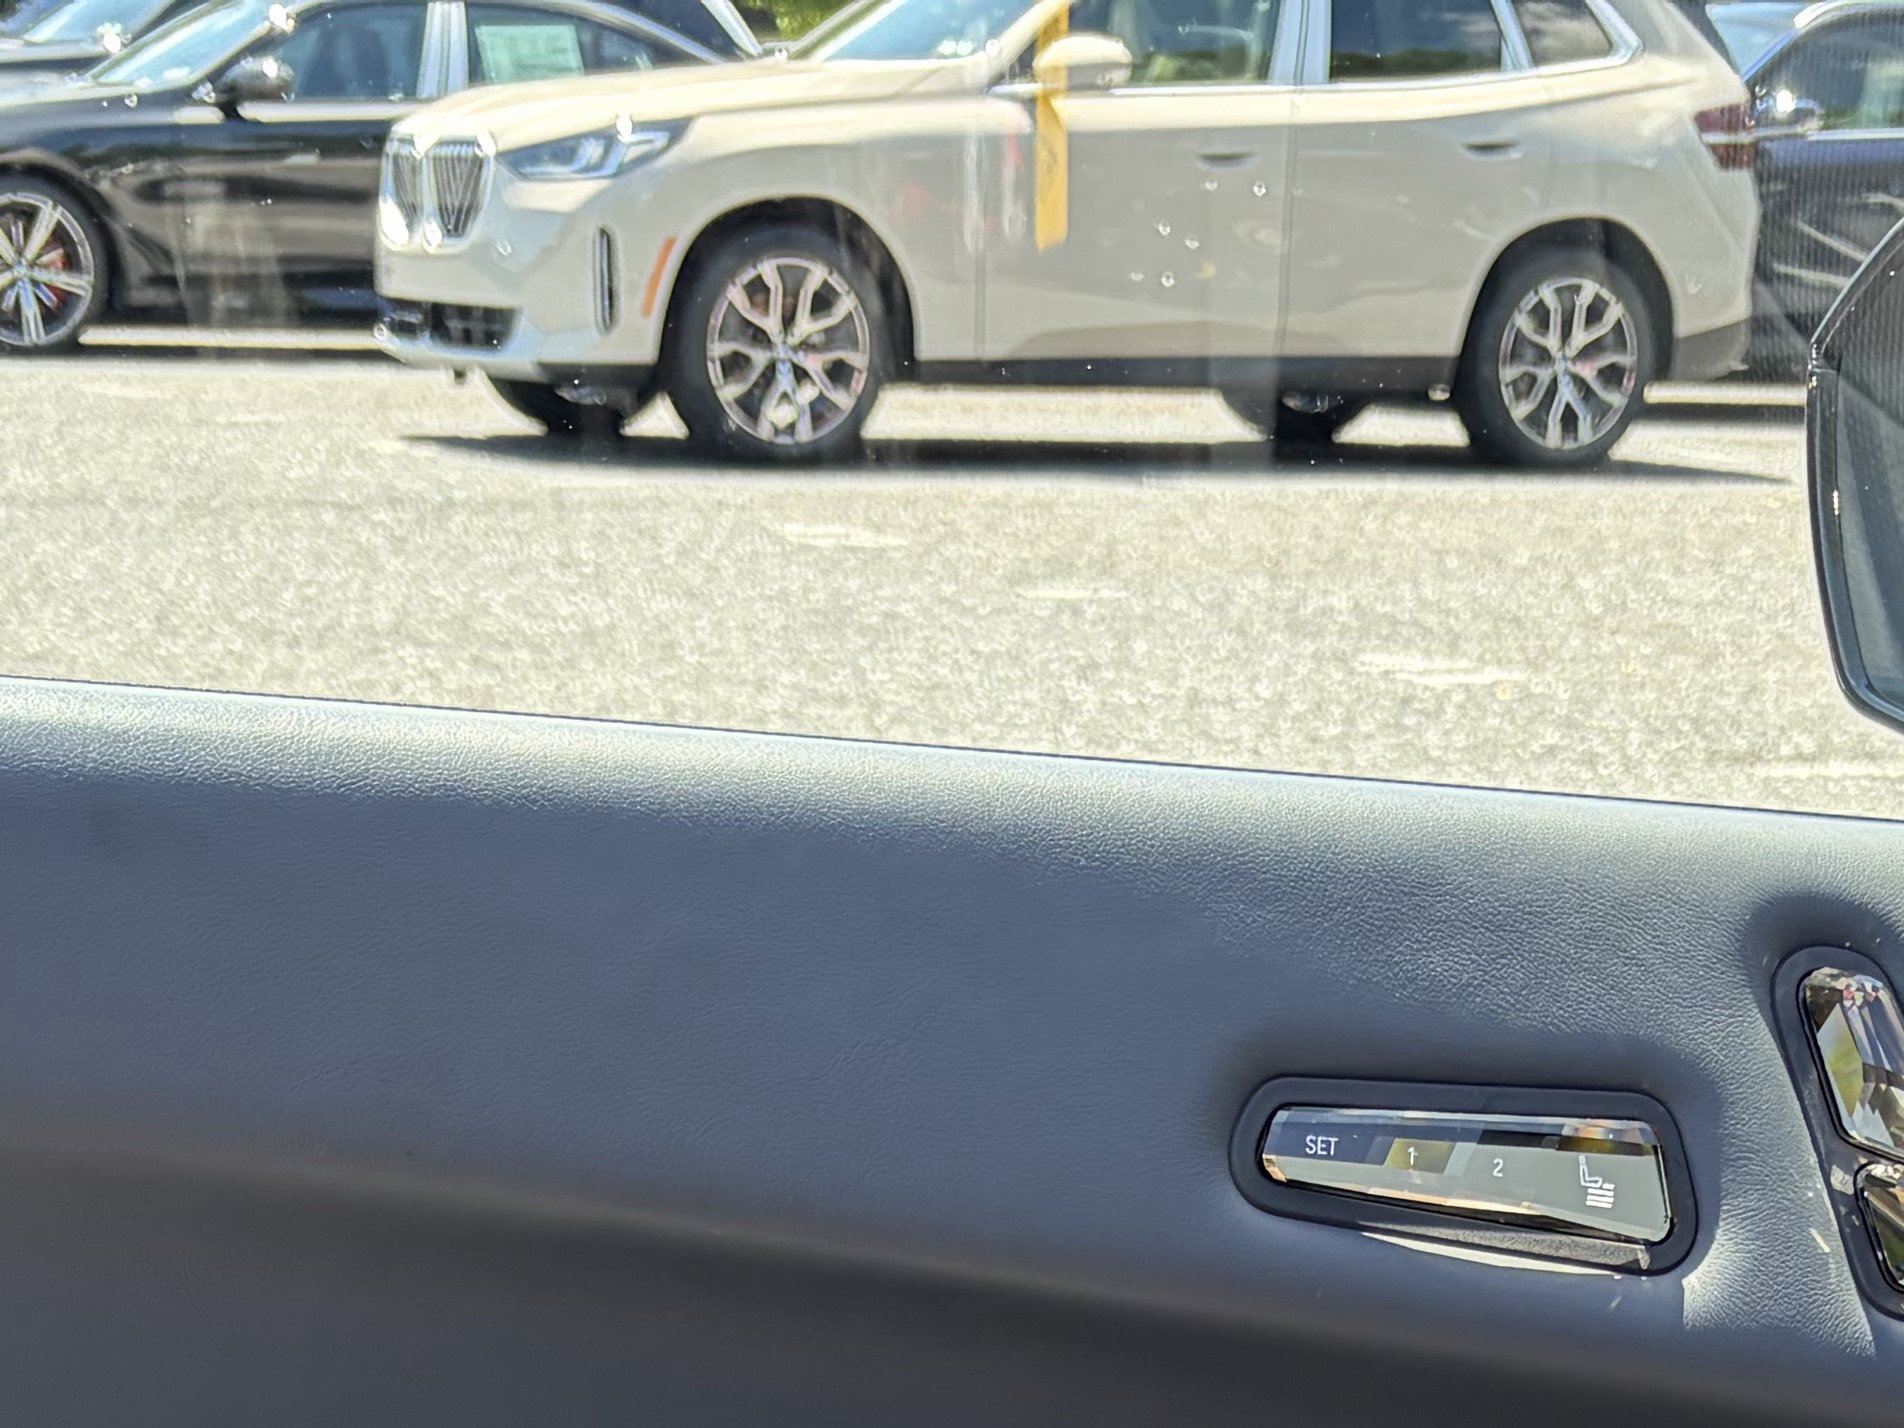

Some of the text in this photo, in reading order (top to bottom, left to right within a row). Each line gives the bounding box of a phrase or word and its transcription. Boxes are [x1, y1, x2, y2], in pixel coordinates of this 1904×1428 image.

[1305, 1135, 1504, 1177] SET 1 2
